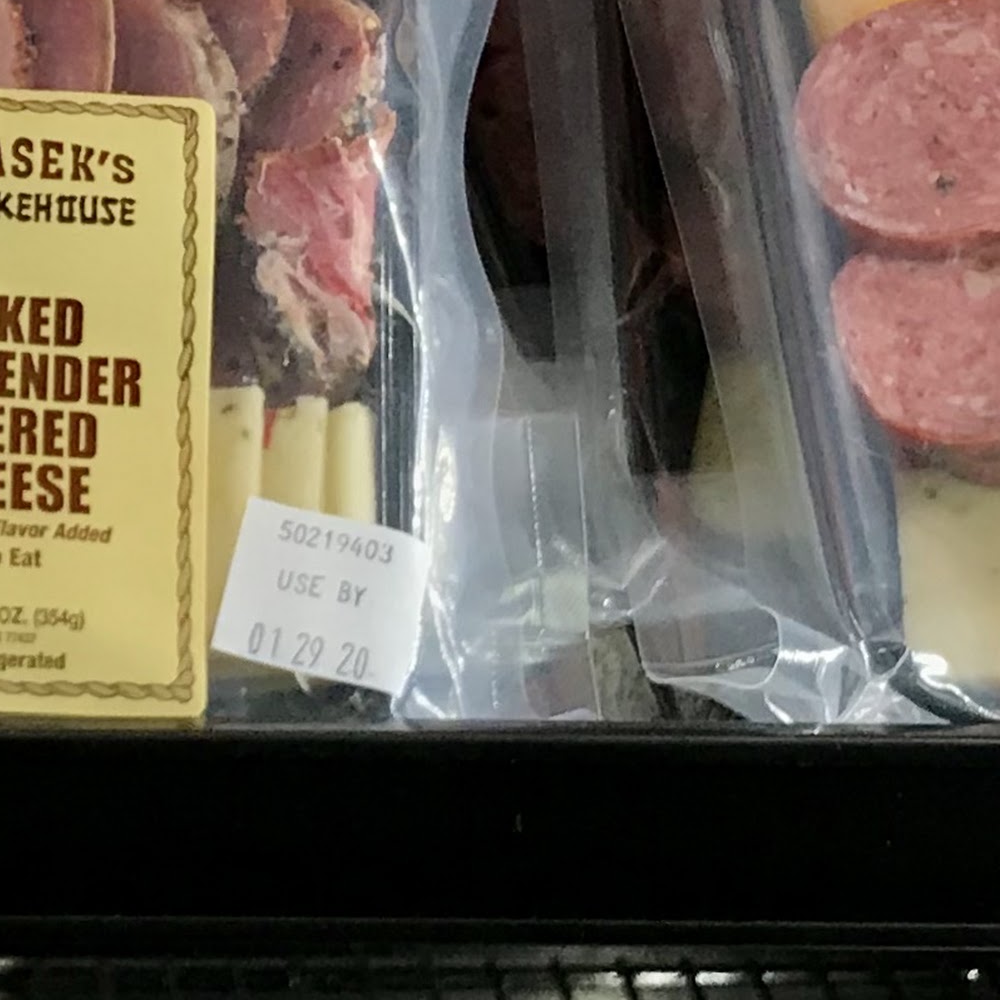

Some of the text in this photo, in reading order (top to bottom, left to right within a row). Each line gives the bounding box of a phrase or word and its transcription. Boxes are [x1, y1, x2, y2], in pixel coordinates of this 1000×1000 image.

[53, 522, 112, 544] Added
[278, 519, 393, 564] 50219403
[10, 547, 42, 567] Eat
[277, 569, 367, 606] USE BY
[33, 607, 85, 630] (354g)
[248, 622, 369, 680] 01 29 20
